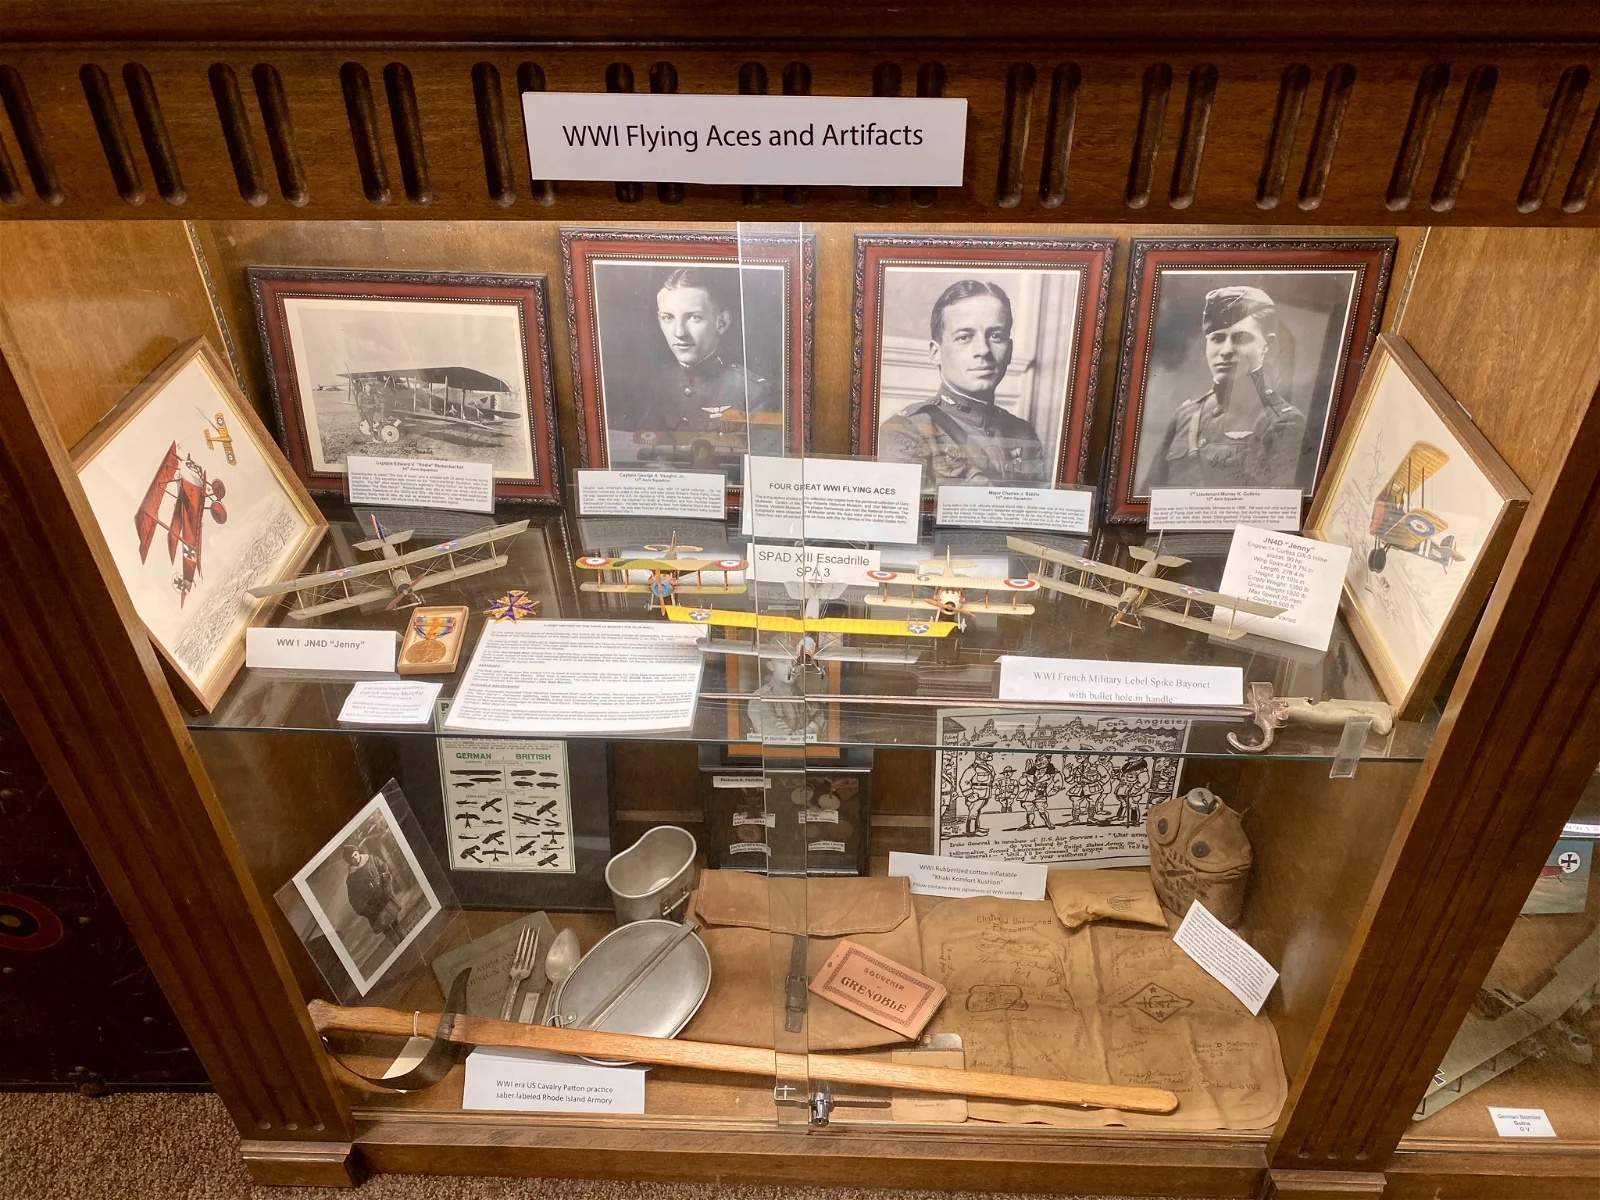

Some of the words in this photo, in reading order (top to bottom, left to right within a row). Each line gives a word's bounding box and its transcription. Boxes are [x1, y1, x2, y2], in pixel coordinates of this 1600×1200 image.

[562, 125, 619, 146] WWI
[627, 125, 698, 152] Flying
[706, 125, 761, 146] Aces
[768, 123, 814, 146] and
[822, 123, 923, 146] Artifacts
[769, 483, 792, 491] FOUR
[843, 486, 871, 494] FLYING
[874, 487, 896, 495] ACES
[1263, 537, 1284, 547] JN4D
[1285, 541, 1315, 553] "Jenny"
[758, 551, 791, 563] SPAD
[817, 553, 870, 566] Escadrille
[1253, 556, 1268, 564] Wing
[1276, 547, 1296, 556] Curtiss
[1297, 551, 1312, 560] OX-5
[796, 566, 821, 577] SPA
[824, 568, 830, 577] 3
[1248, 574, 1265, 584] Empty
[1248, 581, 1264, 589] Gross
[277, 639, 295, 647] WW
[304, 639, 328, 648] JN4D
[330, 640, 365, 650] "Jenny"
[1033, 671, 1057, 681] WWI
[1058, 672, 1086, 682] French
[1088, 673, 1122, 686] Military
[1124, 675, 1148, 685] Lebel
[1150, 677, 1174, 688] Spike
[1176, 679, 1210, 690] Bayonet
[1068, 691, 1087, 699] with
[1089, 691, 1113, 701] bullet
[1115, 692, 1133, 702] hole
[1135, 694, 1143, 702] in
[935, 865, 968, 874] Rubberized
[863, 967, 905, 992] SOUVENIR
[841, 976, 907, 1013] GRENOBLE
[497, 1080, 513, 1088] WWI
[537, 1082, 562, 1092] Cavalry
[563, 1084, 585, 1092] Patton
[586, 1086, 614, 1094] practice
[496, 1091, 515, 1099] saber
[516, 1092, 541, 1100] labeled
[542, 1094, 564, 1102] Rhode
[566, 1095, 585, 1103] Island
[587, 1096, 613, 1105] Armory
